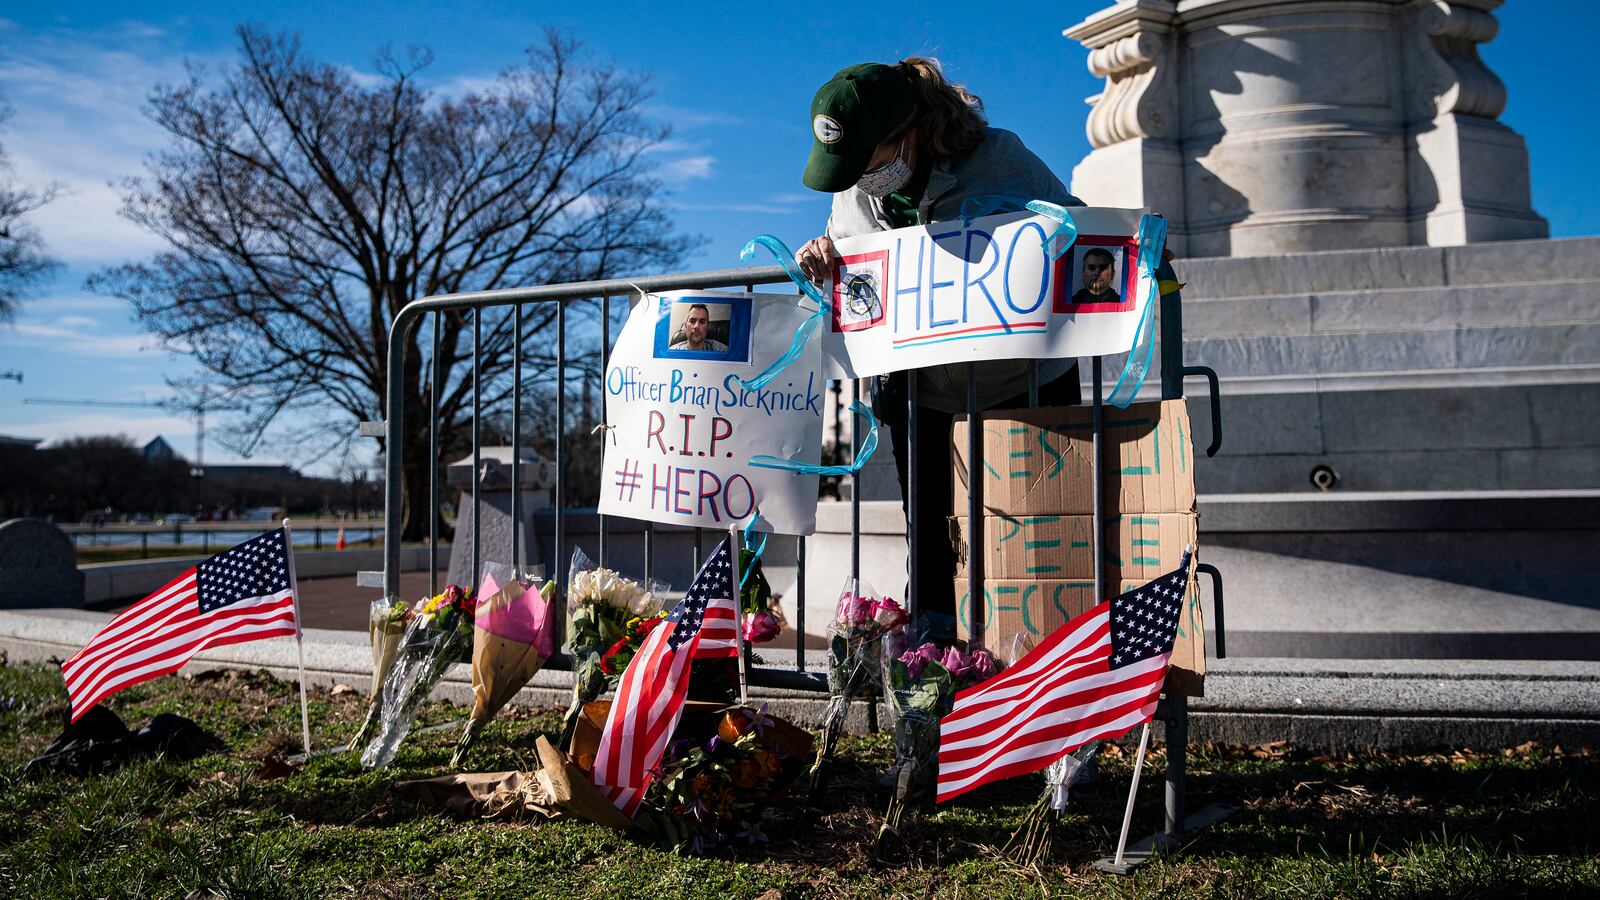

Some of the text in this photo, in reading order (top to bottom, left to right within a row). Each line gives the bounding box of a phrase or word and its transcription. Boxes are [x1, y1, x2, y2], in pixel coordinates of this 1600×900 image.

[893, 221, 1050, 335] HERO
[607, 366, 820, 417] Officer Brian Sicknick
[647, 409, 733, 458] R.I.P.
[1000, 514, 1161, 575] PEACE
